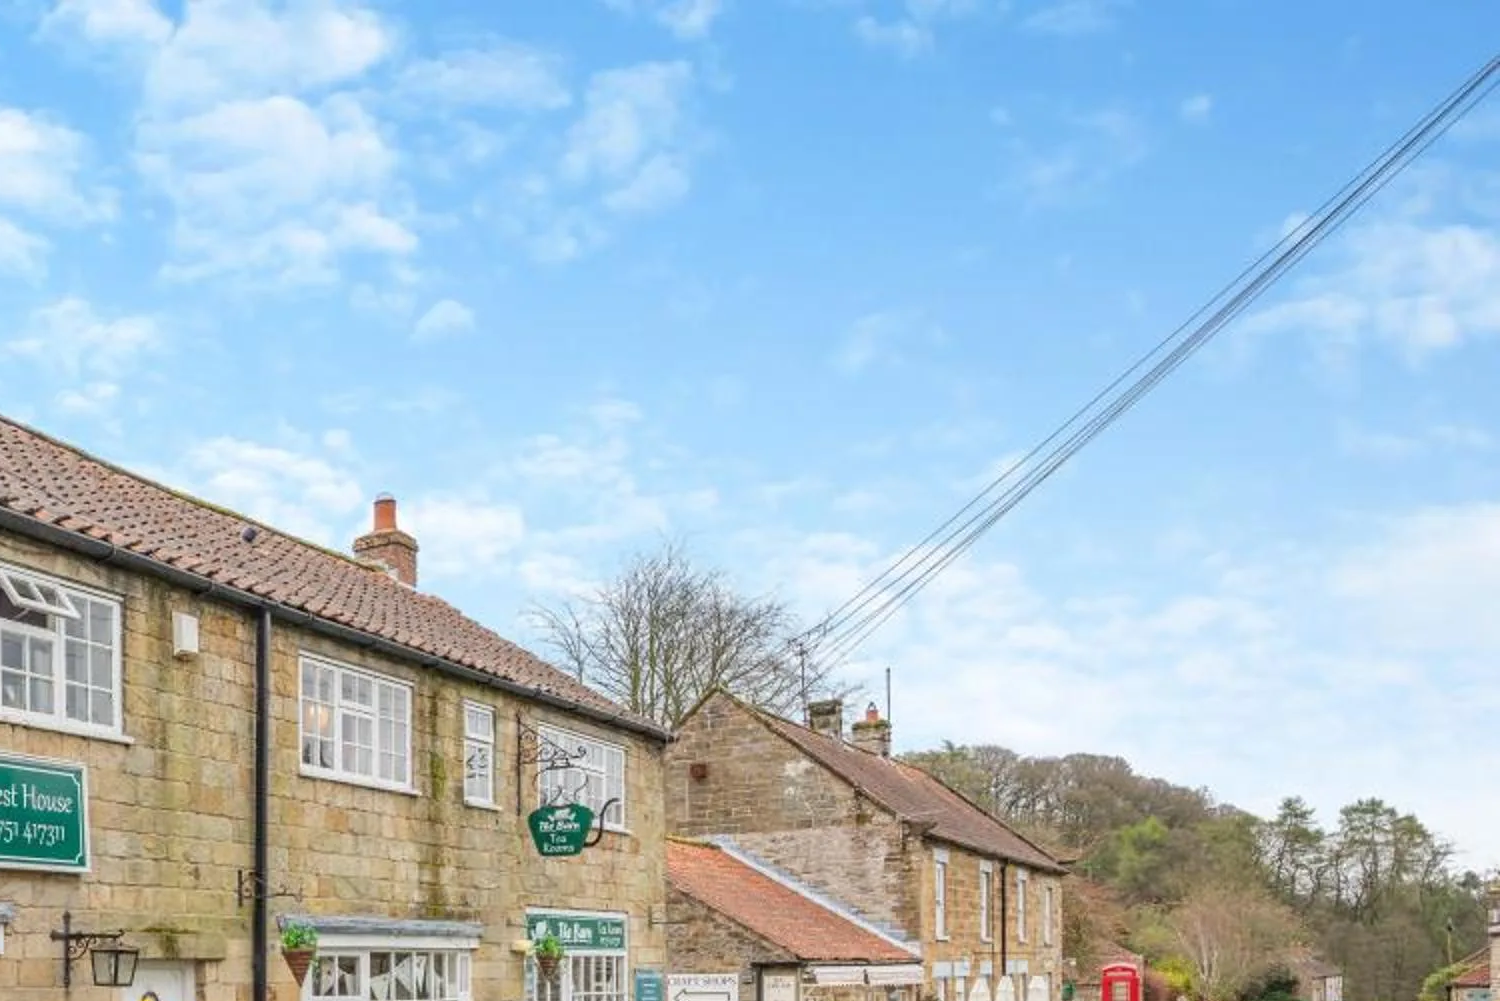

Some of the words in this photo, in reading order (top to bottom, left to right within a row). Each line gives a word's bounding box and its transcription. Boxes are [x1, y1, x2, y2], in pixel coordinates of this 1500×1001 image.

[23, 783, 74, 814] House
[539, 821, 555, 833] The
[556, 821, 581, 833] Barn
[22, 820, 66, 848] 417311
[549, 833, 567, 844] Tea
[702, 976, 737, 987] SHOPS
